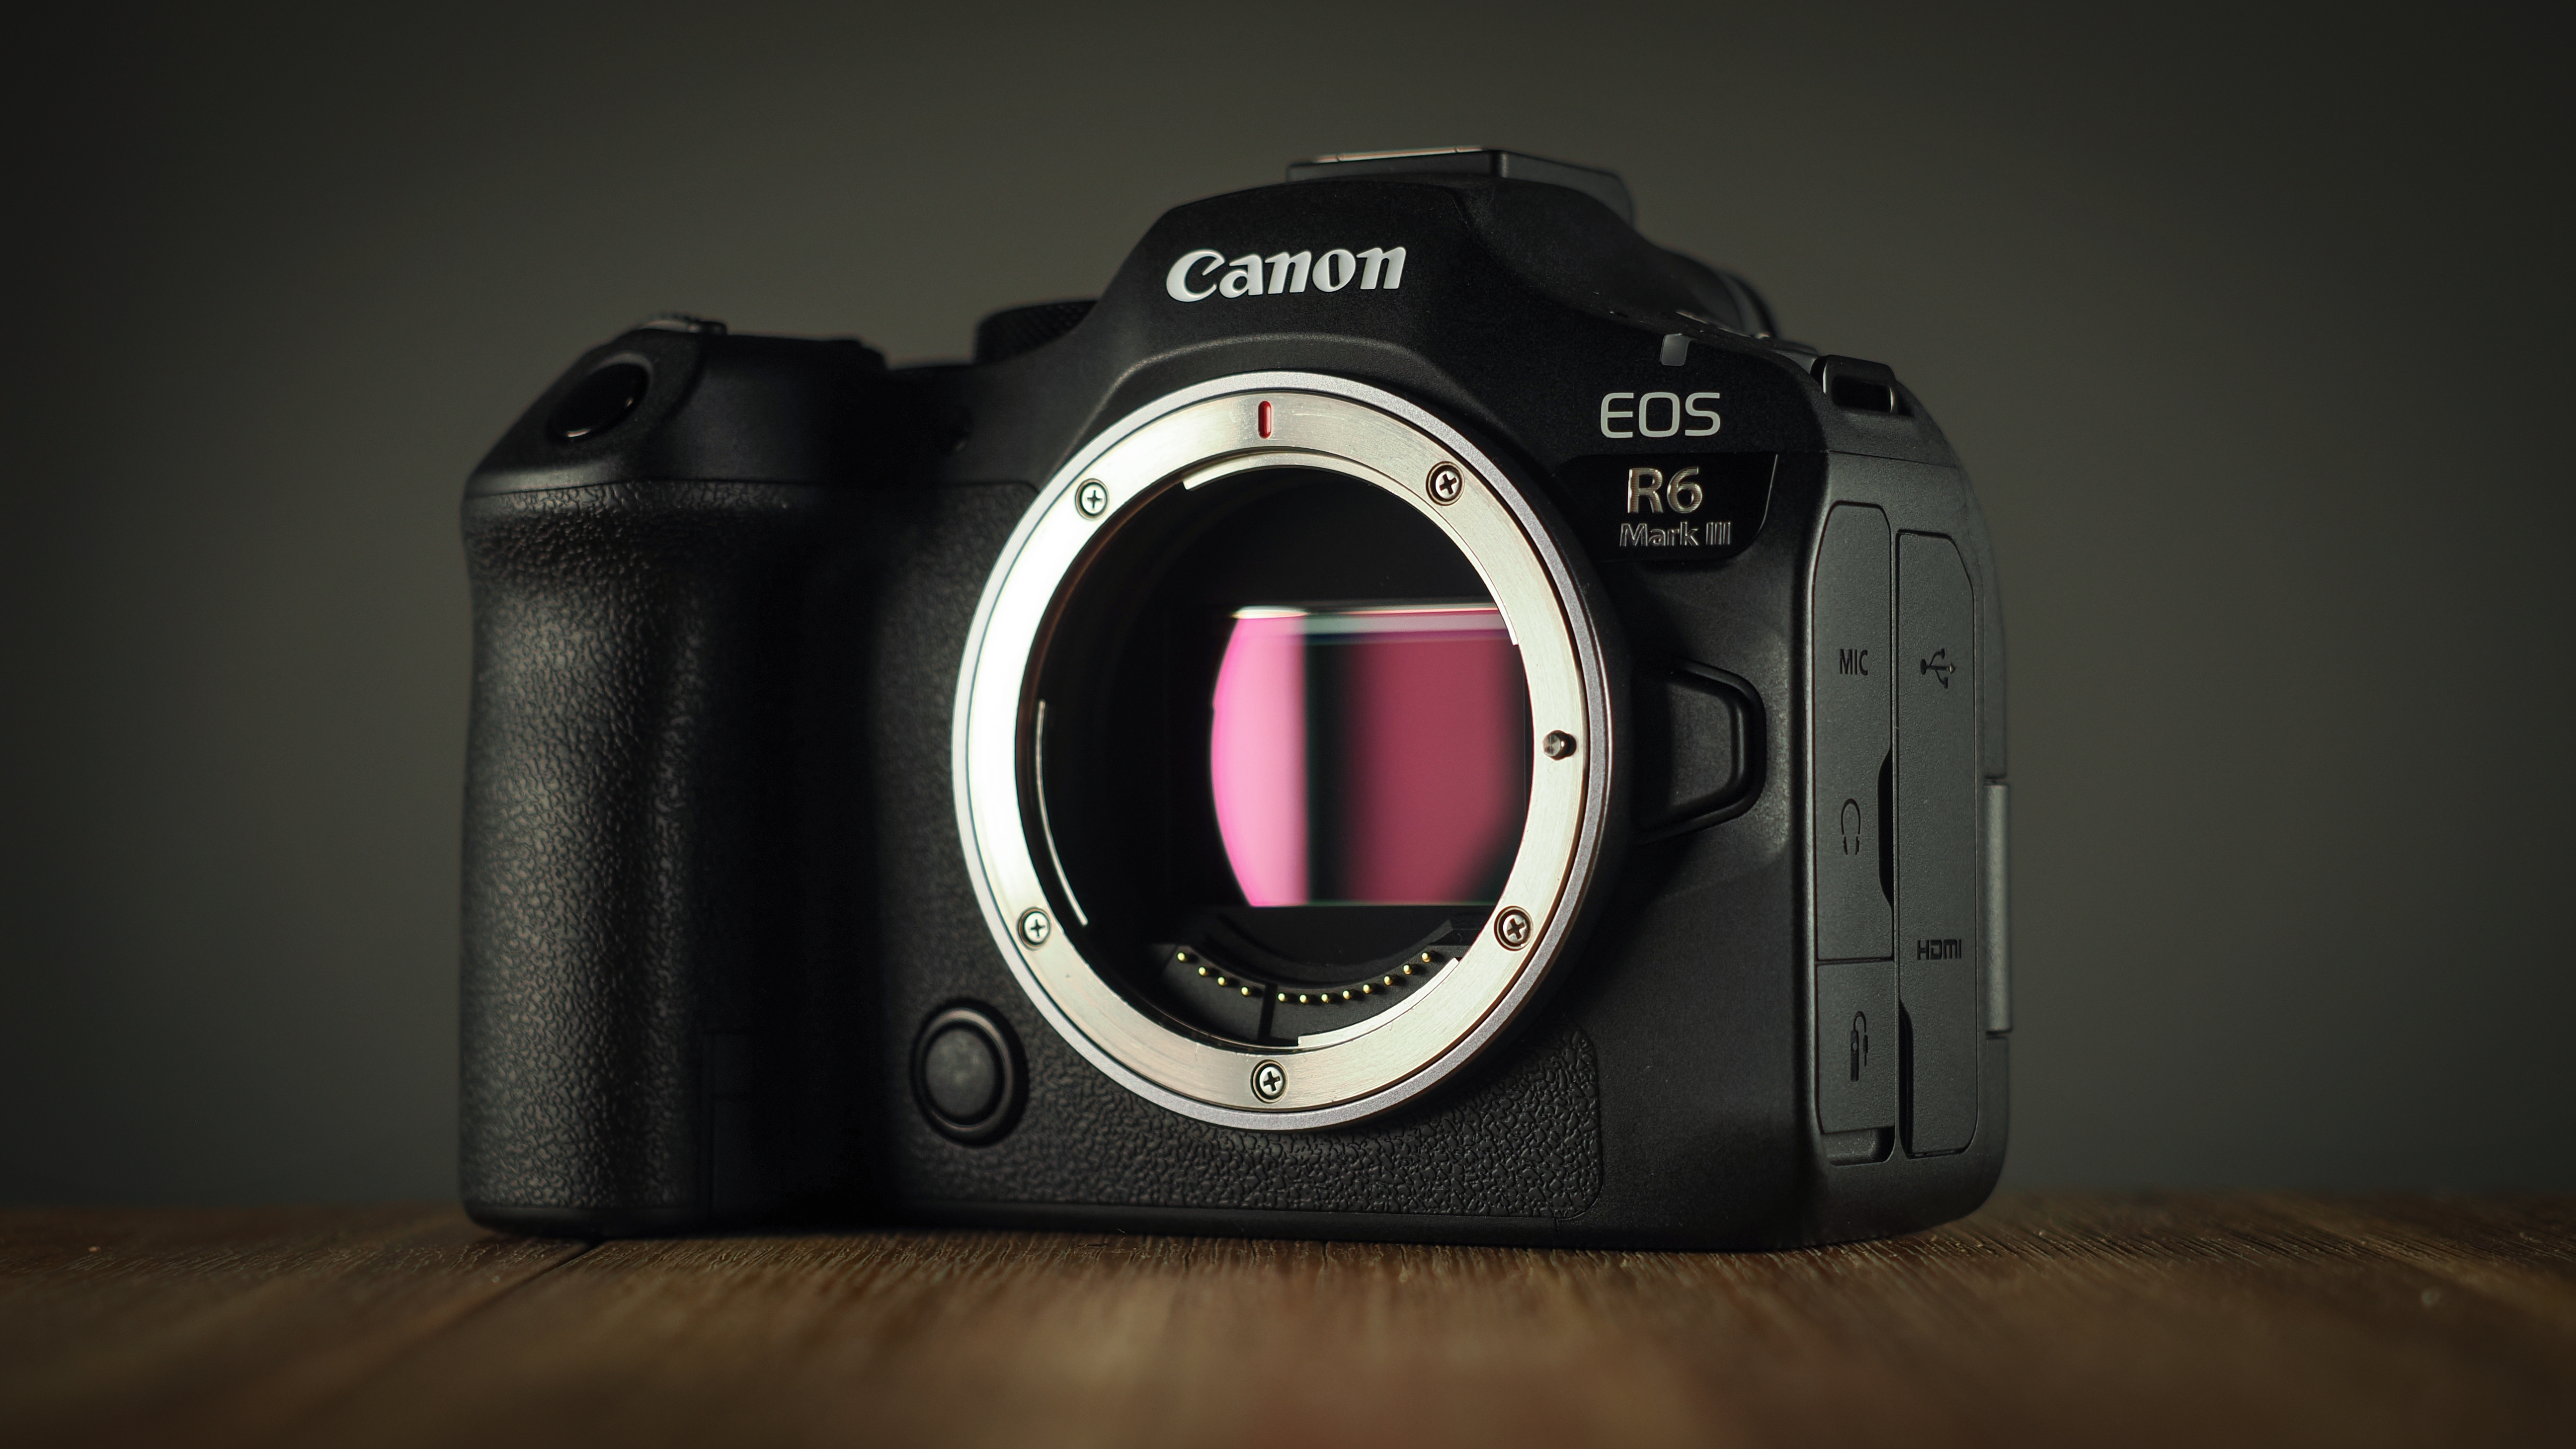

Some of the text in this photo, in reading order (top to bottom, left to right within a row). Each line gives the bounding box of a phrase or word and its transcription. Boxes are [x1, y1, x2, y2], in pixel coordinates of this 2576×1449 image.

[1166, 247, 1406, 302] Canon
[1600, 392, 1721, 439] EOS
[1627, 466, 1703, 514] R6
[1619, 521, 1731, 547] Mark III
[1839, 648, 1869, 676] MIC
[1917, 939, 1962, 961] HDMI
